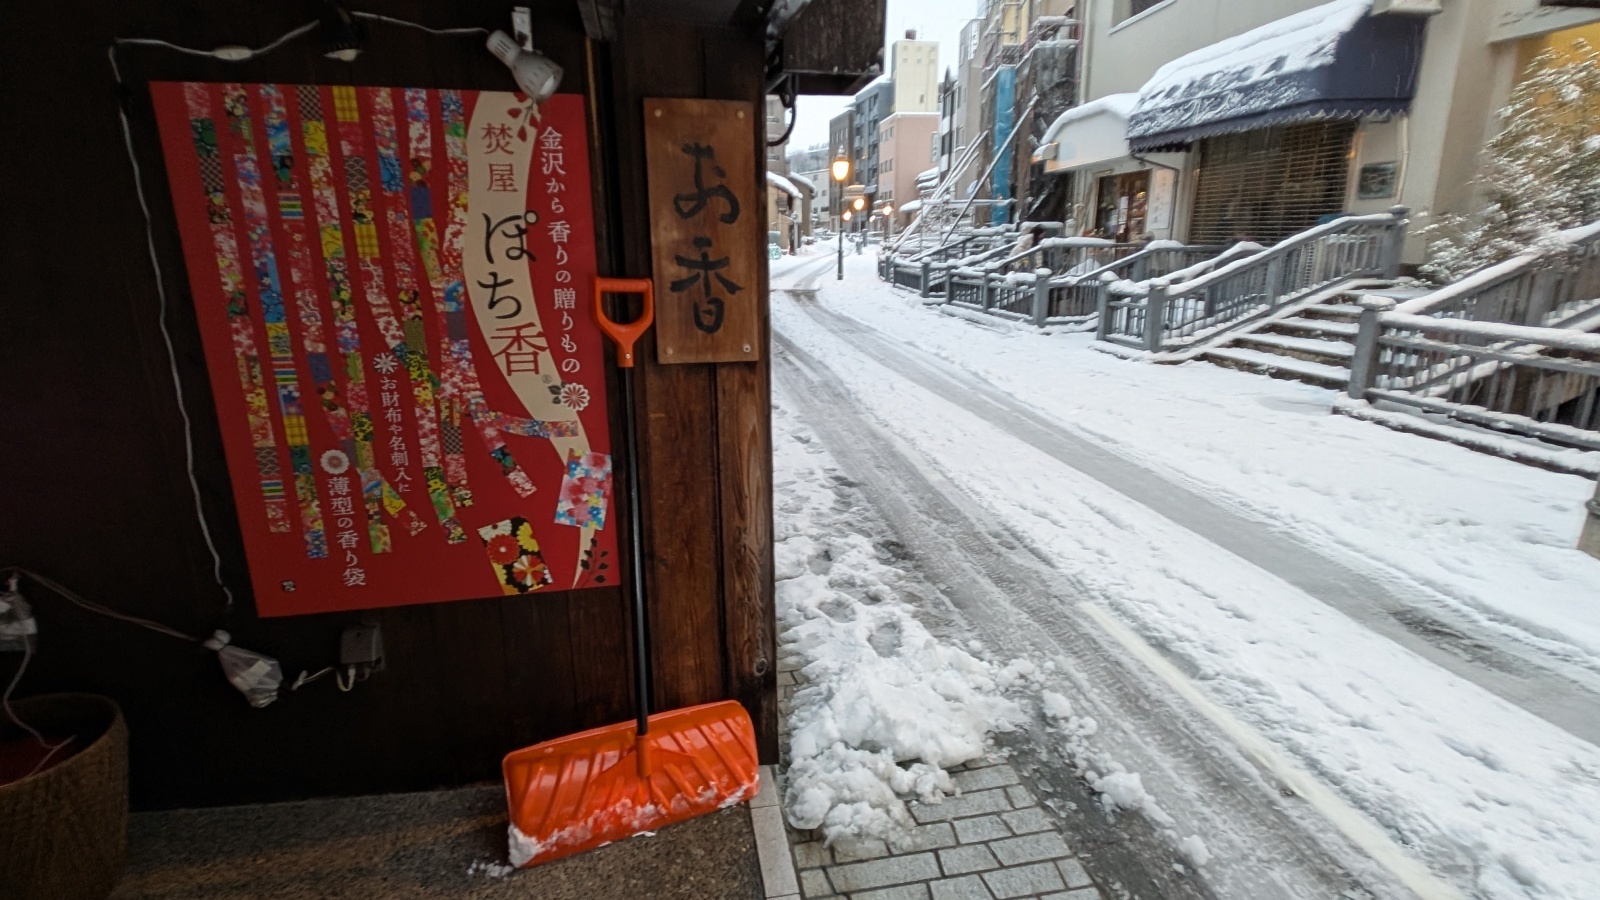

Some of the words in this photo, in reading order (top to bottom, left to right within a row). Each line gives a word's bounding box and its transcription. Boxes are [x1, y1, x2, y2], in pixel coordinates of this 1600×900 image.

[481, 122, 518, 193] 焚屋
[477, 210, 550, 377] ぽち香
[539, 126, 581, 373] 金沢から香りの贈りもの
[669, 142, 745, 334] お香
[380, 376, 412, 493] お財布や名刺入に
[327, 476, 366, 587] 薄型の香り袋
